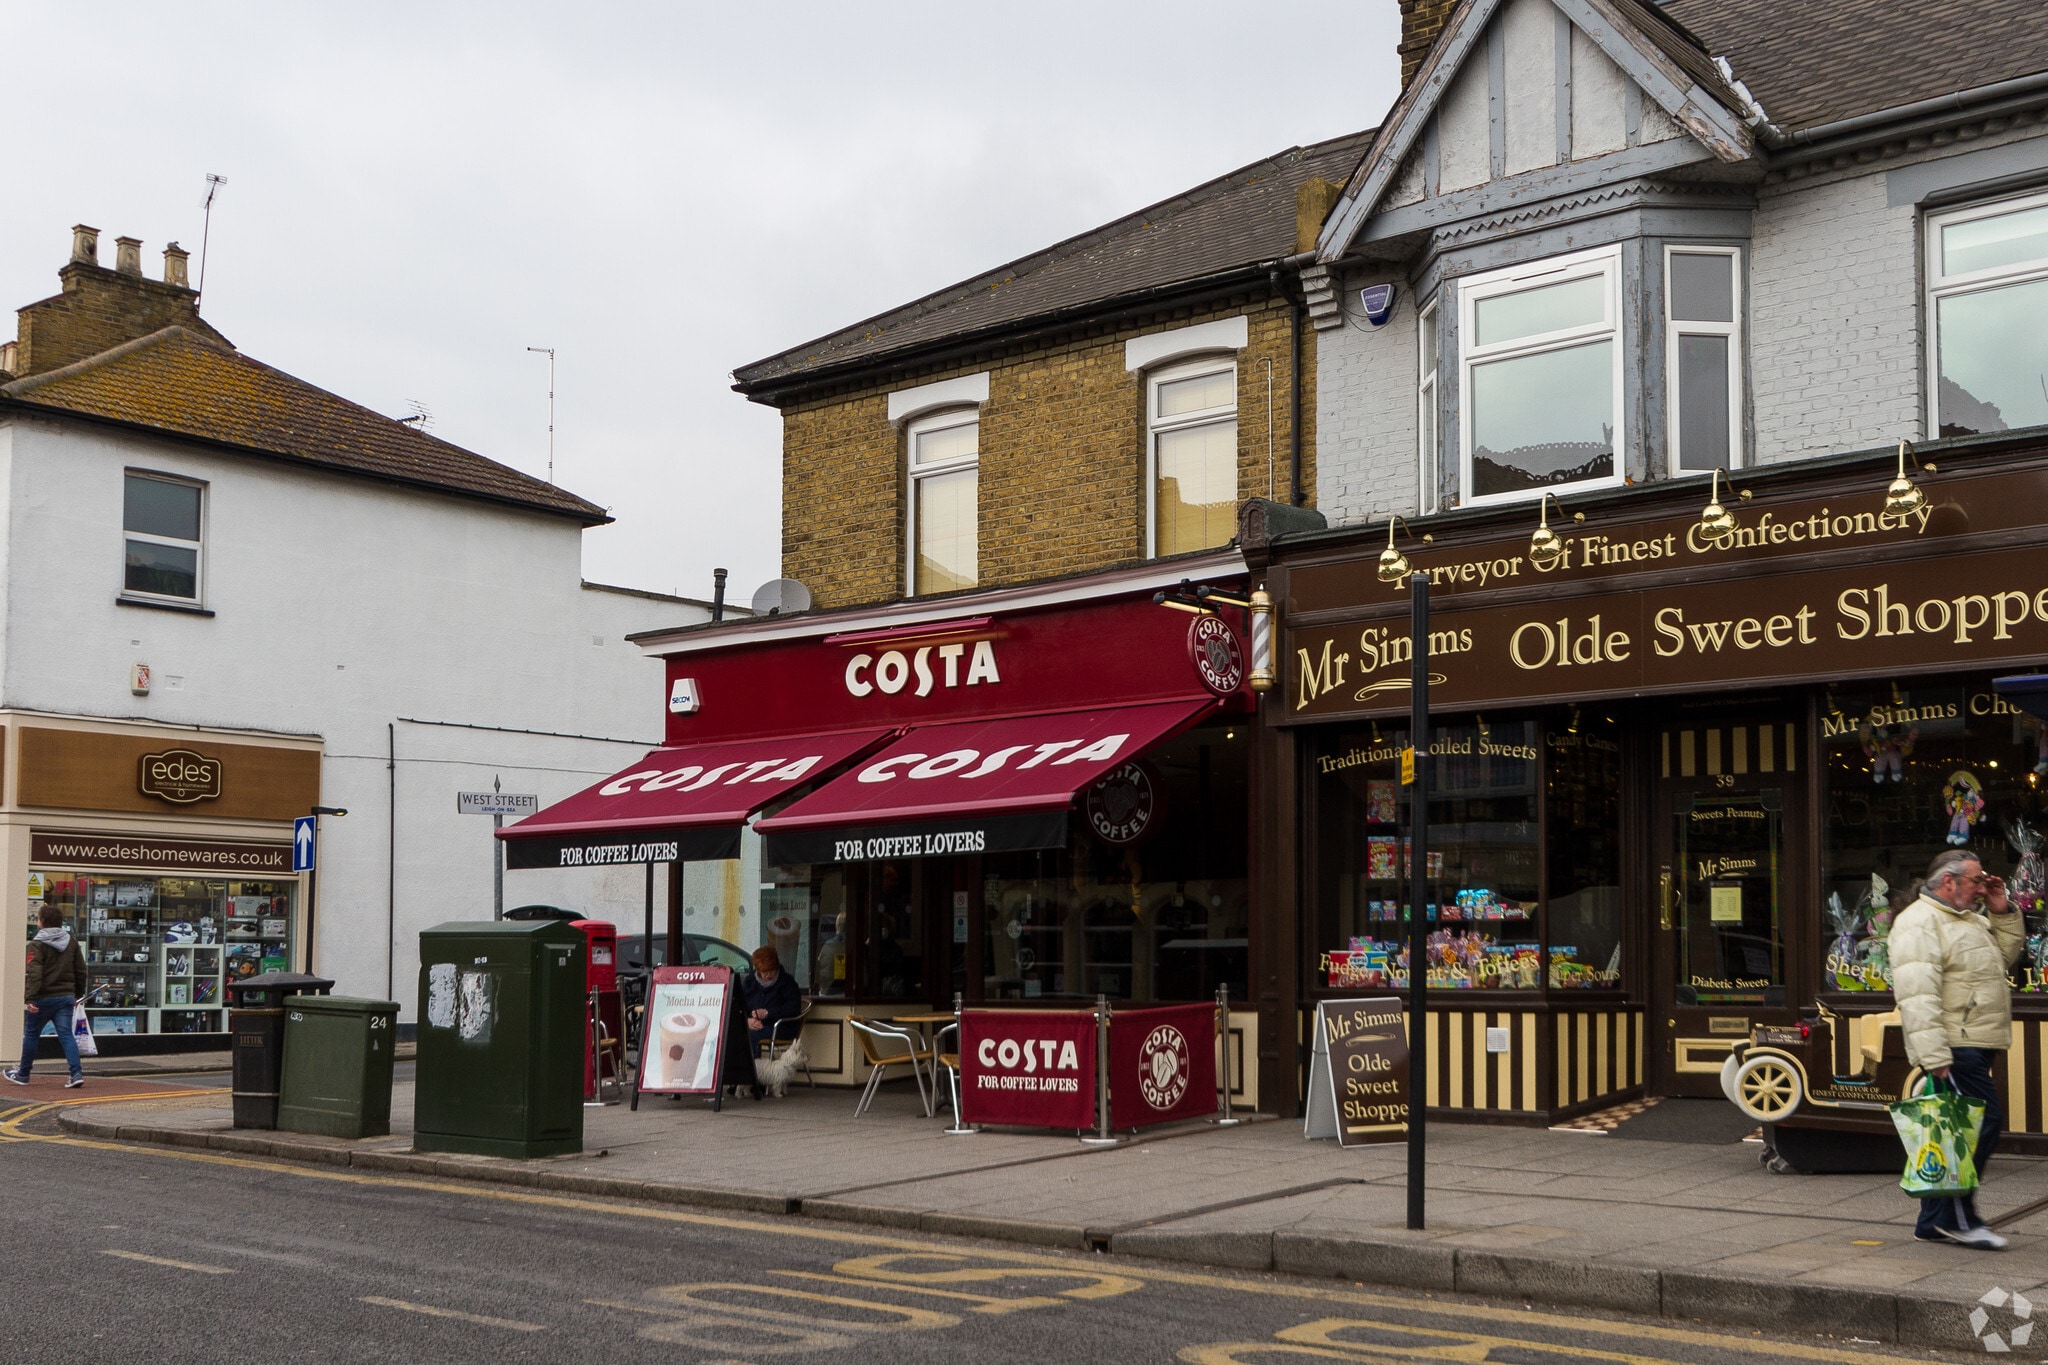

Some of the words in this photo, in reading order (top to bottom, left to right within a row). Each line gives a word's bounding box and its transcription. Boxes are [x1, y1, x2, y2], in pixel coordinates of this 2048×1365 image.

[1394, 554, 1523, 590] rveyor
[1580, 533, 1676, 567] Finest
[1686, 504, 1934, 554] Confectionery
[1199, 621, 1231, 644] COSTA
[1509, 614, 1631, 670] Olde
[1653, 605, 1817, 656] Sweet
[845, 640, 1001, 698] COSTA
[1200, 660, 1240, 689] COFFEE
[1296, 639, 1350, 711] Mr
[1360, 626, 1473, 674] Simms
[1821, 714, 1860, 738] Mr
[1870, 700, 1958, 728] Simms
[1429, 736, 1472, 756] oiled
[1478, 736, 1538, 760] Sweets
[1546, 731, 1582, 749] Candy
[152, 758, 212, 782] edes
[858, 734, 1130, 784] COSTA
[599, 755, 824, 796] COSTA
[1716, 774, 1735, 788] 39
[462, 793, 492, 806] WEST
[494, 794, 535, 807] STREET
[1093, 808, 1148, 838] COFFEE
[1691, 808, 1724, 822] Sweets
[1726, 807, 1766, 820] Peanuts
[48, 844, 282, 866] www.edeshomewares.co.uk
[560, 846, 584, 866] FOR
[585, 844, 629, 864] COFFEE
[631, 842, 678, 862] LOVERS
[834, 840, 864, 860] FOR
[866, 836, 922, 858] COFFEE
[924, 830, 986, 853] LOVERS
[1698, 860, 1718, 882] Mr
[1720, 856, 1757, 874] Simms
[676, 972, 706, 982] COSTA
[1318, 952, 1374, 981] Fudge,
[1380, 962, 1445, 980] Noat
[1450, 962, 1468, 980] &
[1474, 954, 1539, 976] Toffees
[1586, 967, 1620, 982] Sours
[1826, 953, 1894, 982] Sherbe
[2024, 968, 2048, 986] Li
[1691, 975, 1734, 989] Diabetic
[1736, 976, 1770, 988] Sweets
[666, 996, 695, 1006] Mocha
[698, 996, 721, 1006] Latte
[370, 1016, 388, 1029] 24
[1326, 1013, 1352, 1045] Mr
[1354, 1010, 1402, 1032] Simms
[1146, 1028, 1182, 1055] COSTA
[978, 1038, 1079, 1074] COSTA
[1348, 1052, 1392, 1072] Olde
[978, 1074, 999, 1090] FOR
[1000, 1076, 1038, 1092] COFFEE
[1039, 1076, 1079, 1092] LOVERS
[1143, 1074, 1186, 1106] COFFEE
[1346, 1076, 1400, 1096] Sweet
[1830, 1084, 1868, 1093] PURVEYOR
[1837, 1090, 1898, 1102] CONFECTIONERY
[1343, 1101, 1409, 1124] Shoppe
